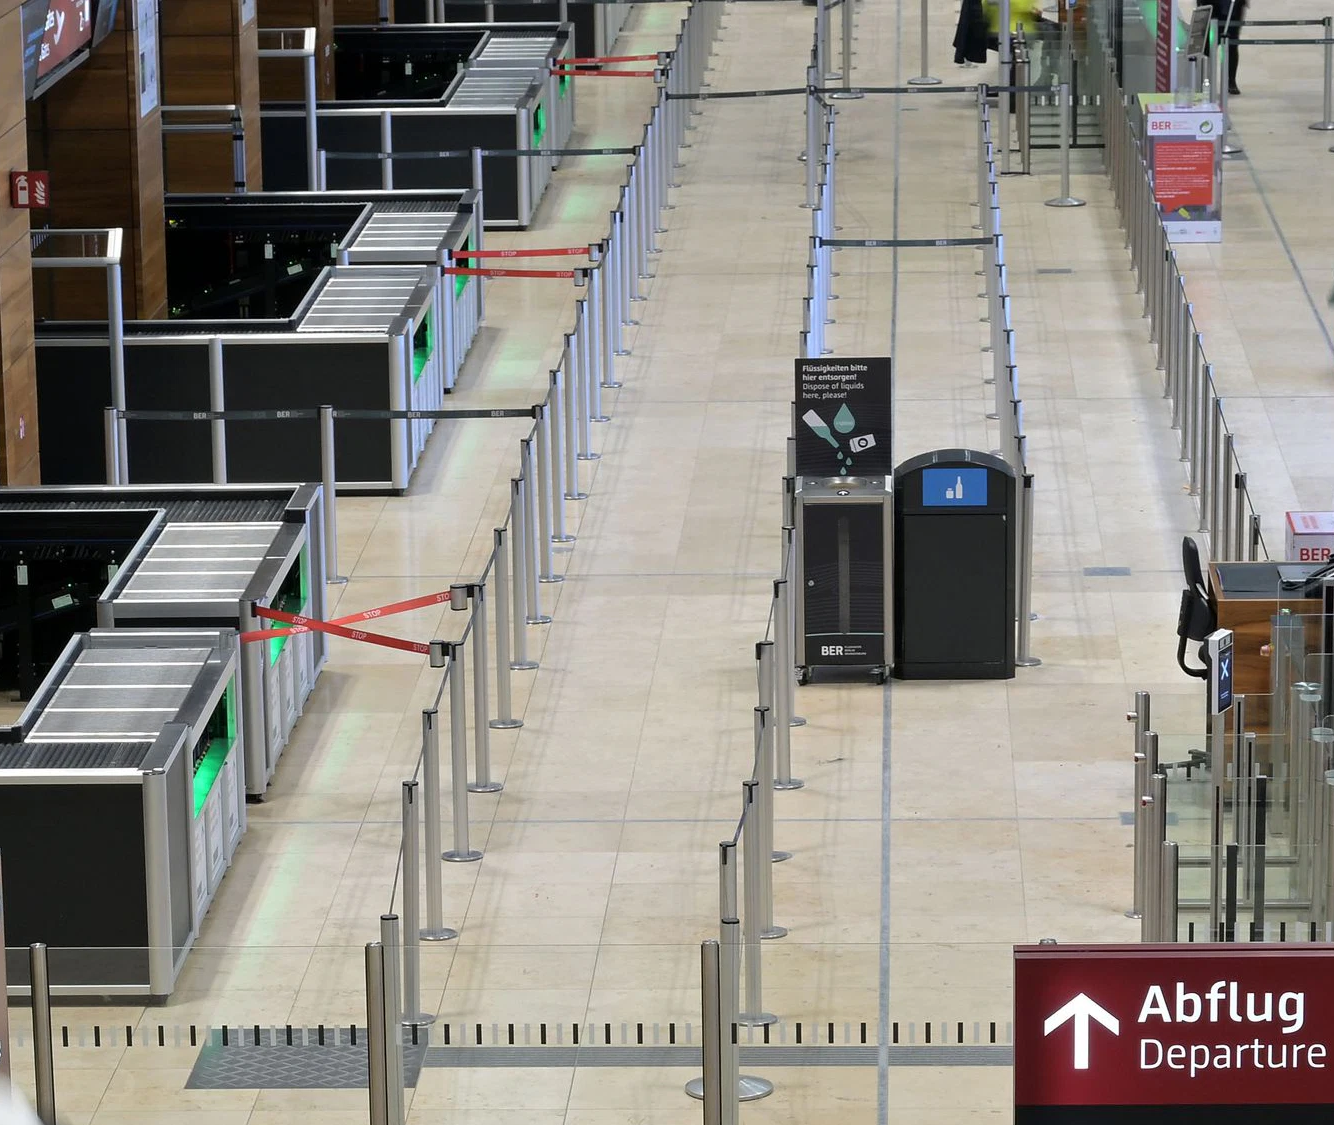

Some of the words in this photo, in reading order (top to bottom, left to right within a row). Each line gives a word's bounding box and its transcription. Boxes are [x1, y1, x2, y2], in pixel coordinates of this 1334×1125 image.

[1151, 121, 1172, 130] BER
[802, 364, 849, 374] Flüssigkeiten
[818, 374, 857, 382] entsorgen!
[802, 383, 829, 391] Dispose
[840, 382, 865, 391] liquids
[802, 391, 821, 399] here,
[822, 391, 847, 400] please!
[1299, 548, 1331, 561] BER
[363, 609, 381, 619] STOP
[436, 593, 450, 602] STO
[292, 616, 308, 624] STOP
[351, 630, 367, 640] STOP
[413, 643, 428, 652] STOP
[821, 645, 844, 656] BER
[1137, 981, 1305, 1034] Abflug
[1140, 1038, 1327, 1078] Departure
